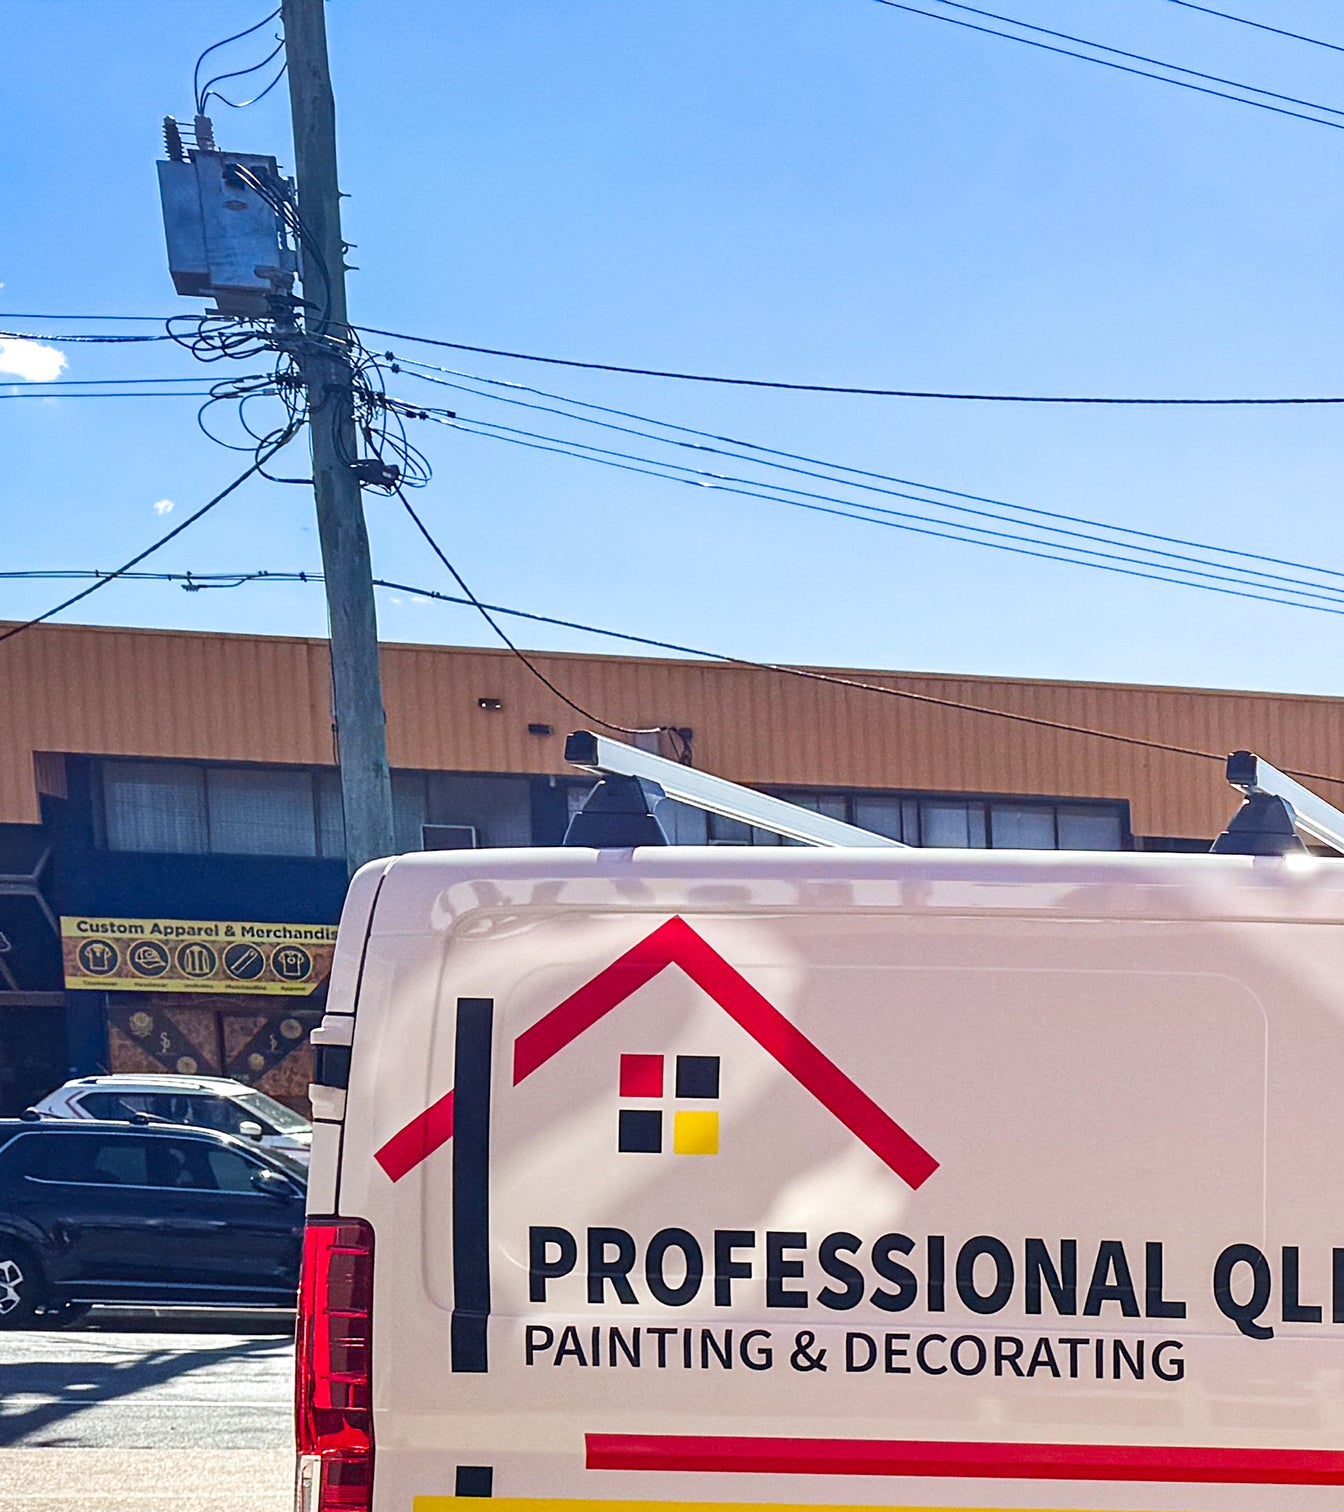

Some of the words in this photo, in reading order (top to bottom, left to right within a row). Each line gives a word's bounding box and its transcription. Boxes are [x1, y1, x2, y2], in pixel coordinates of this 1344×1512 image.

[77, 920, 145, 935] Custom
[150, 922, 219, 939] Apparel
[224, 926, 236, 938] &
[241, 926, 337, 941] Merchandis
[528, 1226, 1187, 1319] PROFESSIONAL
[525, 1324, 774, 1372] PAINTING
[788, 1331, 829, 1373] &
[845, 1332, 1186, 1381] DECORATING
